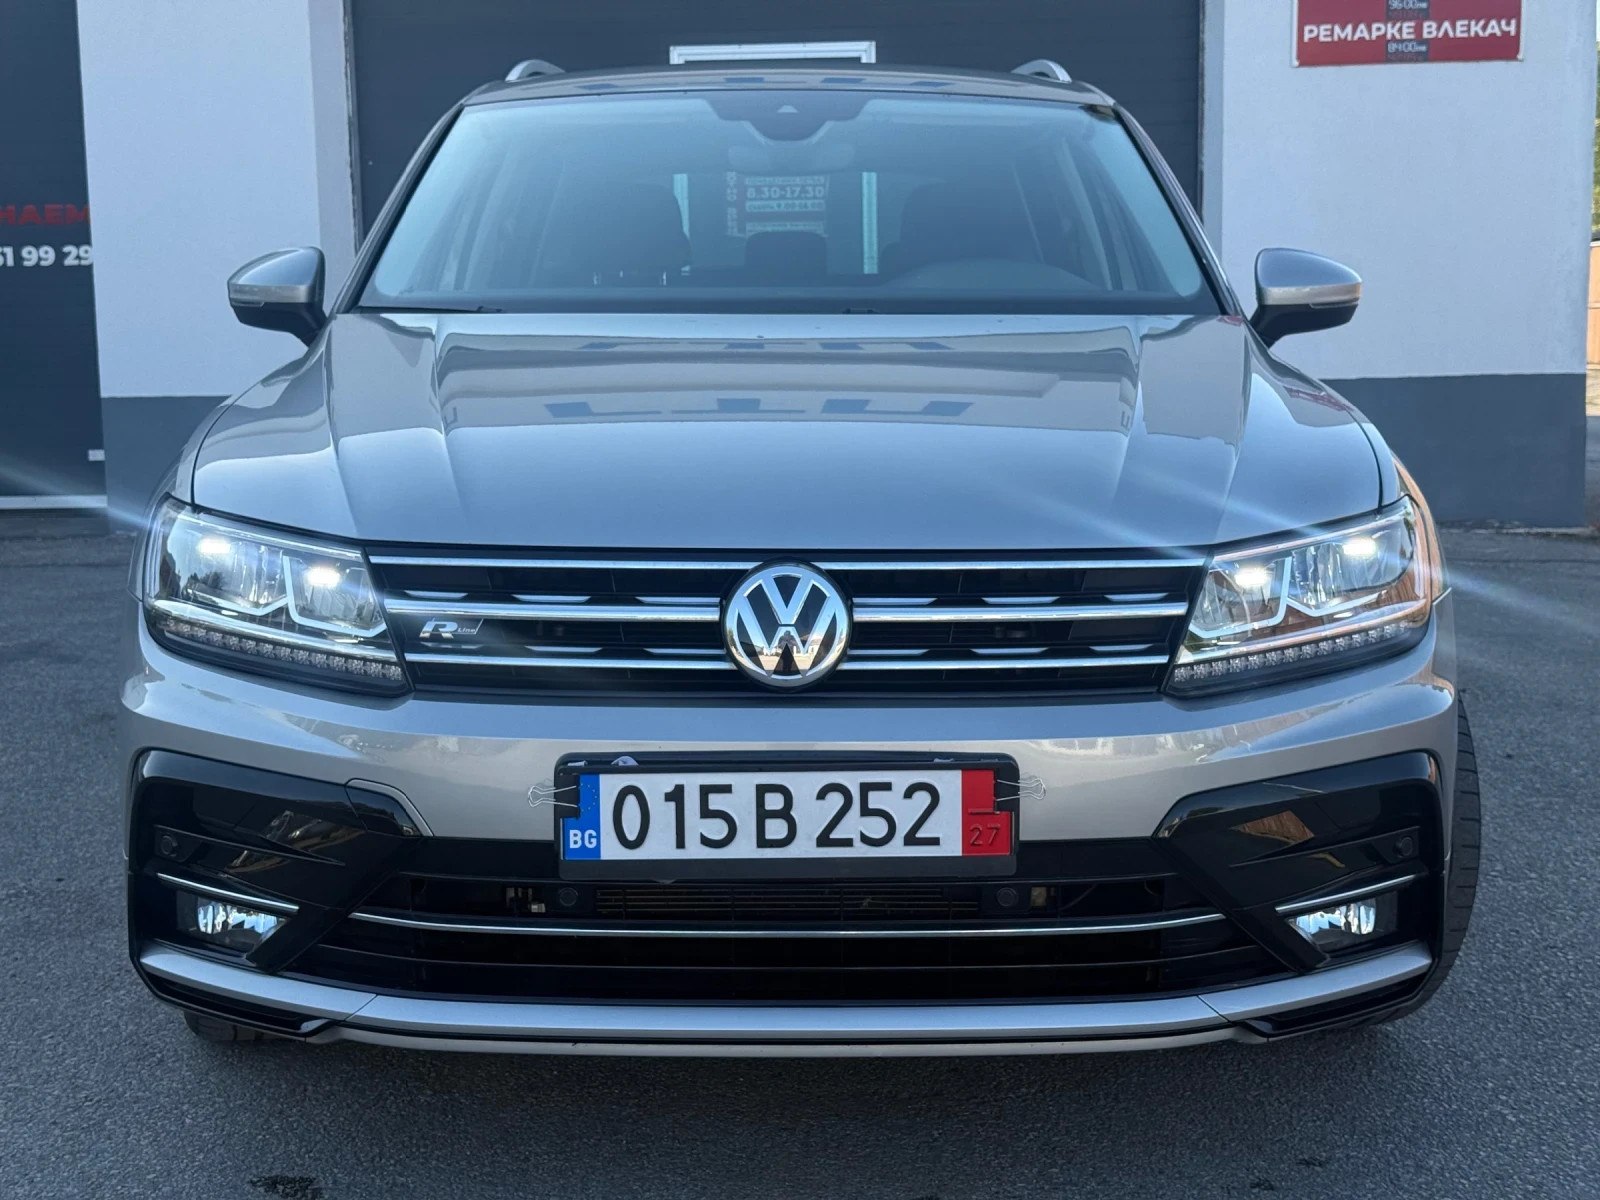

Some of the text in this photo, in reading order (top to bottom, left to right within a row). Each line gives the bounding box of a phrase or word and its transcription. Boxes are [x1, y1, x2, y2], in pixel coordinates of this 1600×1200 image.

[1303, 18, 1517, 42] РЕМАРКЕ ВЛЕКАЧ
[21, 245, 56, 267] 99
[62, 244, 93, 266] 29
[569, 829, 597, 849] BG
[969, 823, 1000, 846] 27
